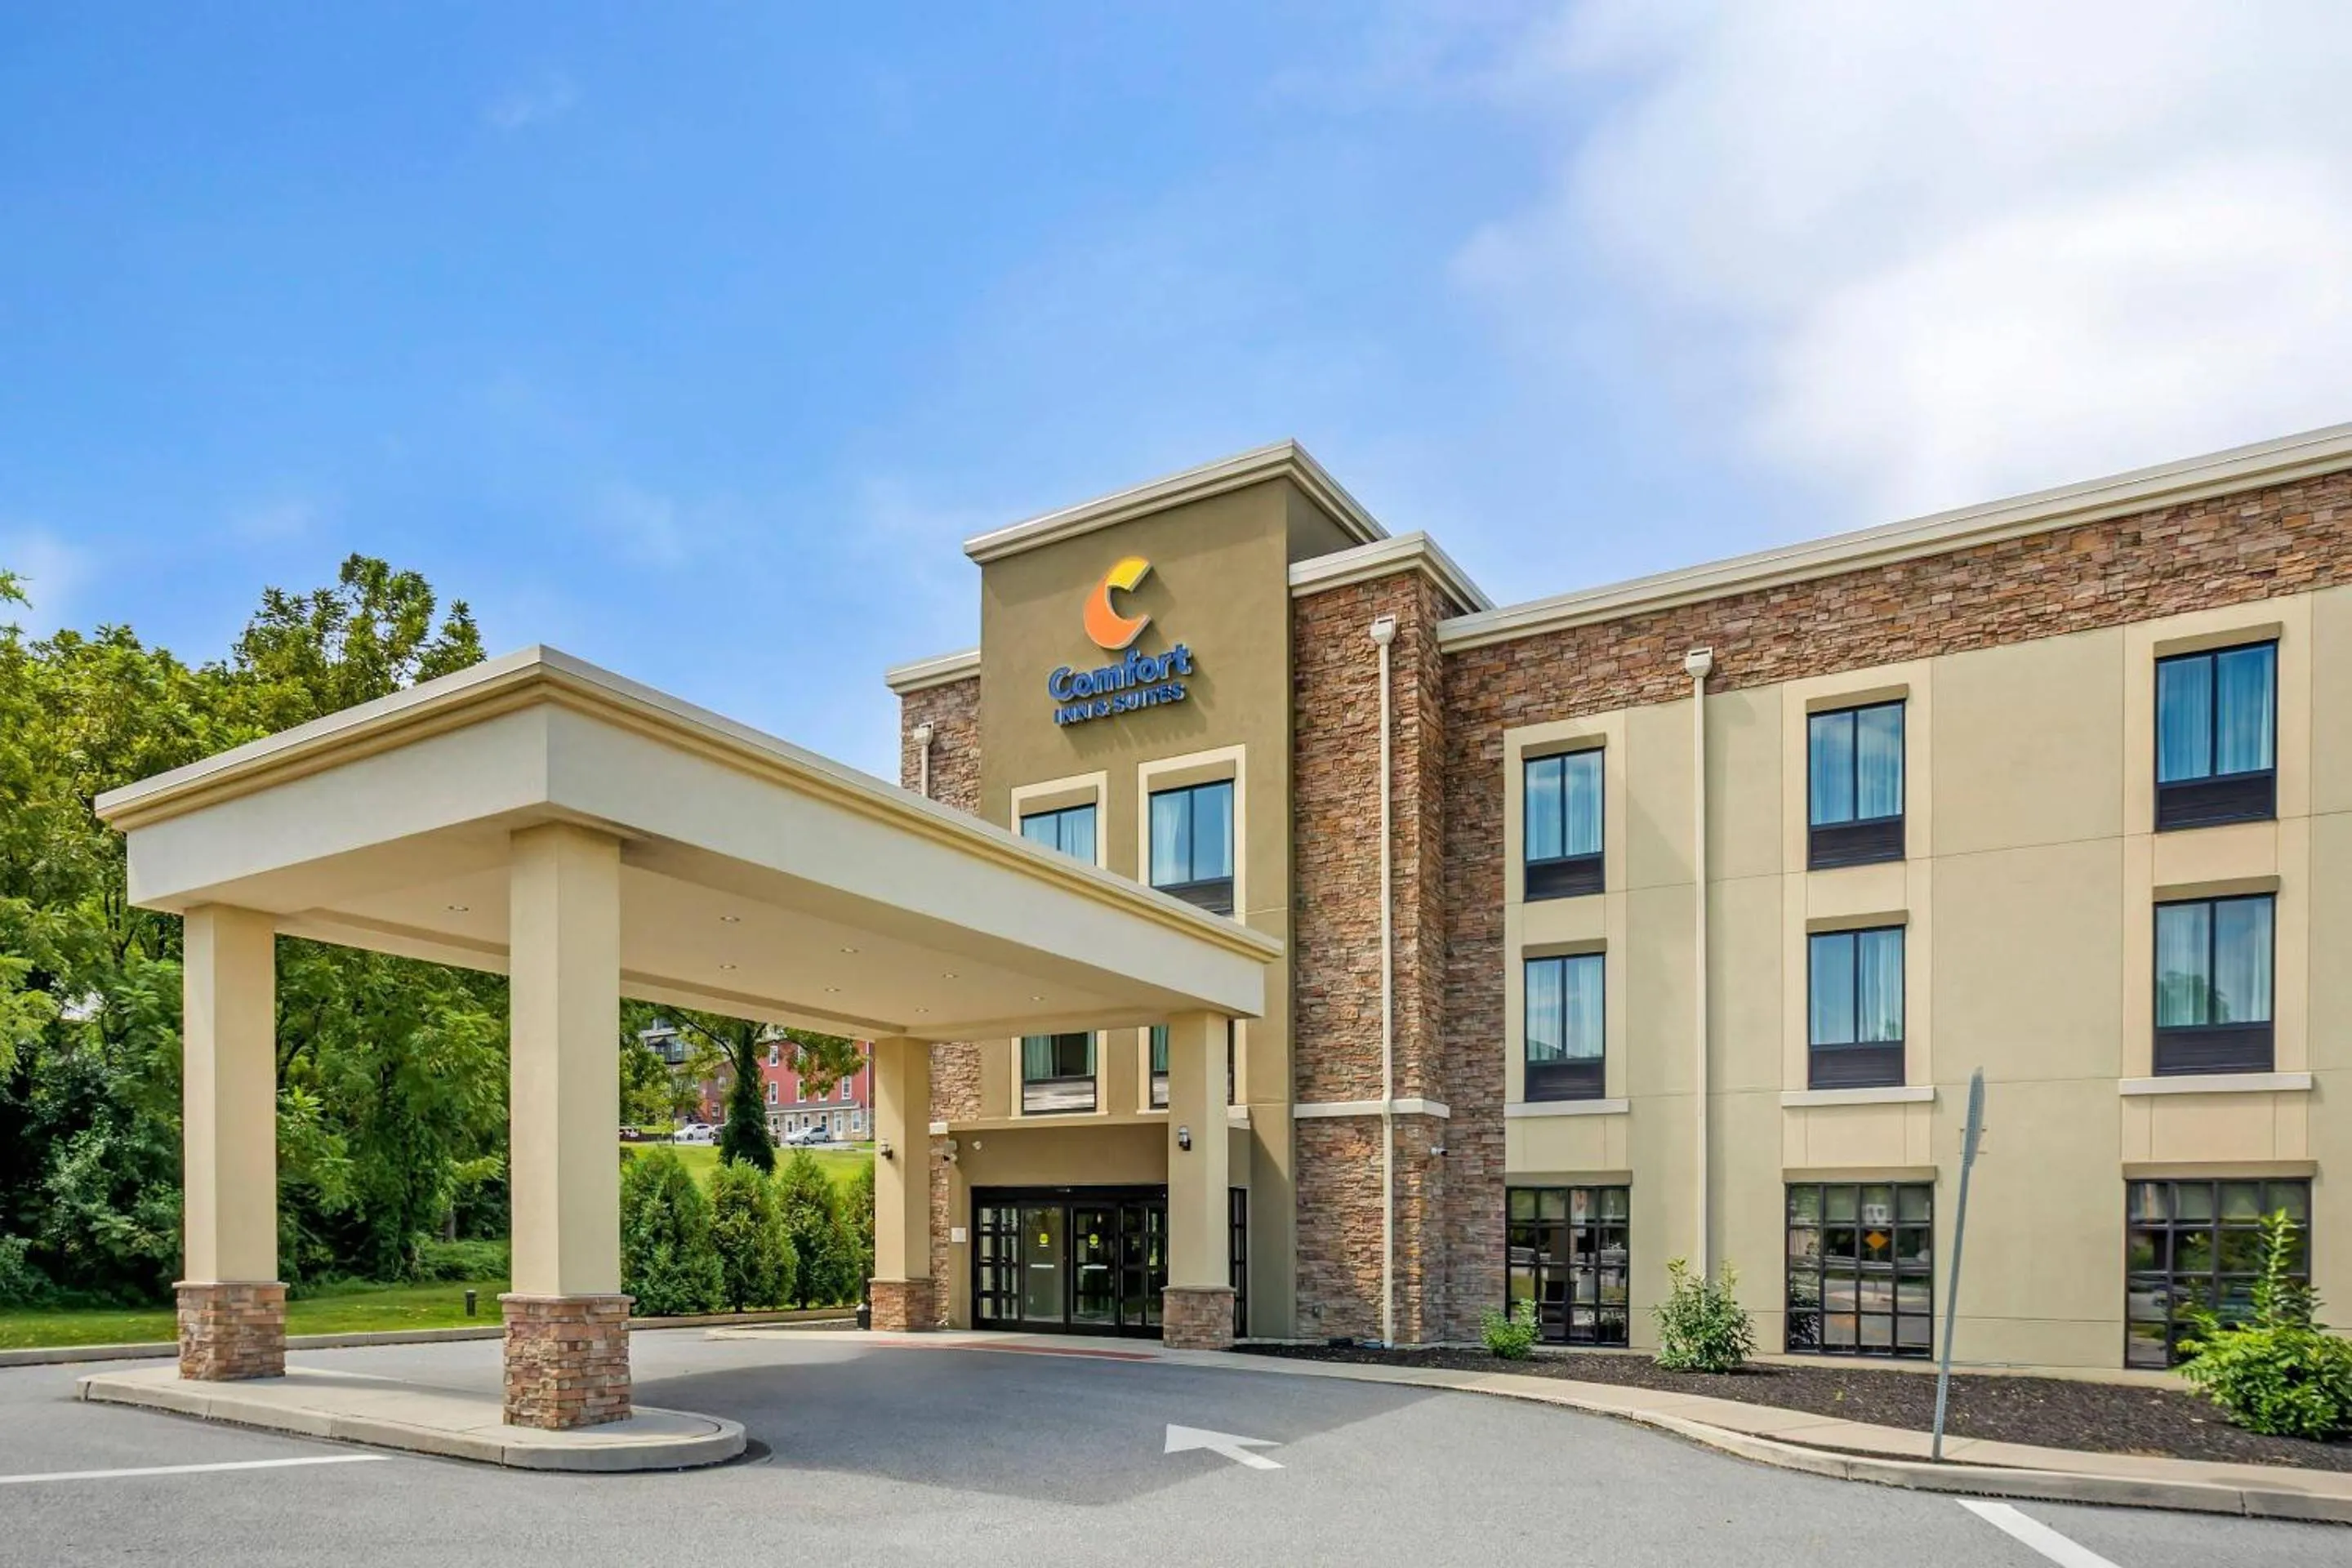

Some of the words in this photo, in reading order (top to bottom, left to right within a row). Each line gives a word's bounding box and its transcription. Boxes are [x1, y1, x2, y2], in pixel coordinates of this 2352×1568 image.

[1049, 643, 1192, 702] Comfort
[1054, 703, 1093, 725] INN
[1094, 697, 1111, 718] &
[1112, 680, 1187, 714] SUITES
